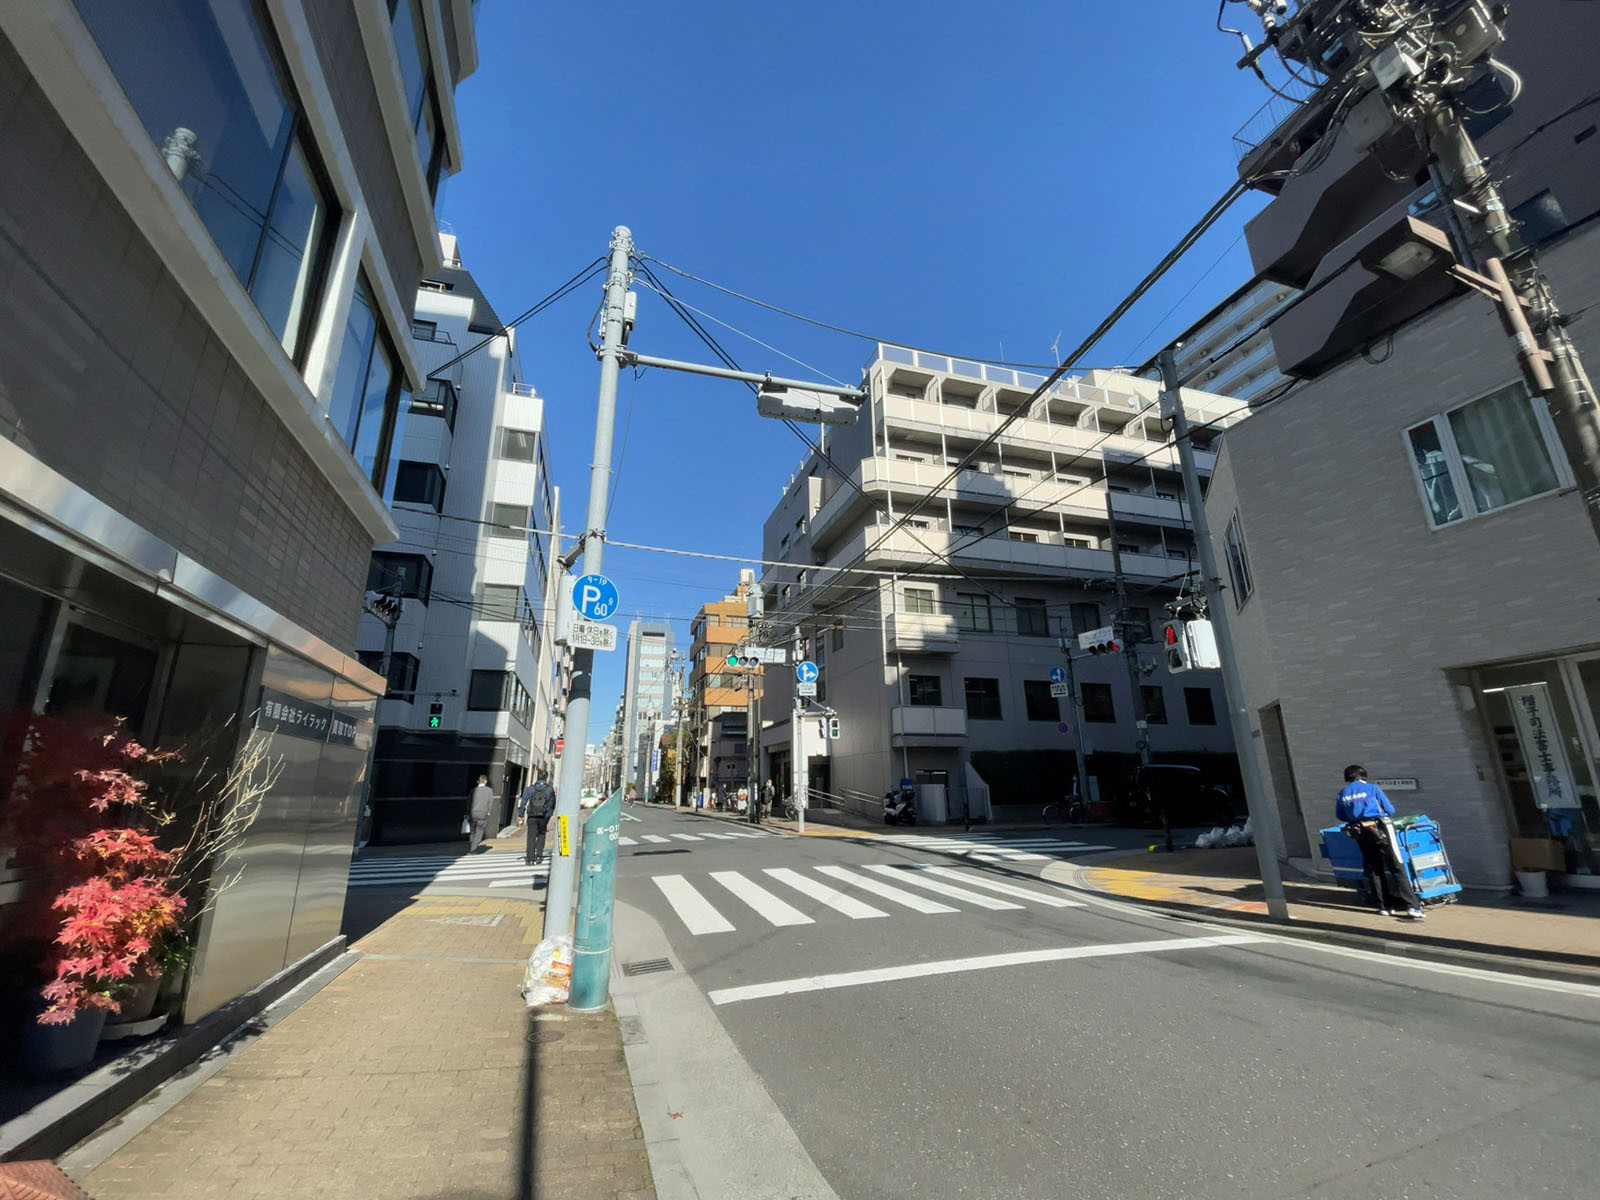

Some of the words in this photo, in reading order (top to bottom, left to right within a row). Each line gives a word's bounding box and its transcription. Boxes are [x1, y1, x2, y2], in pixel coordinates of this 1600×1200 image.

[581, 584, 601, 614] P
[265, 700, 327, 731] 有限会社ライラック
